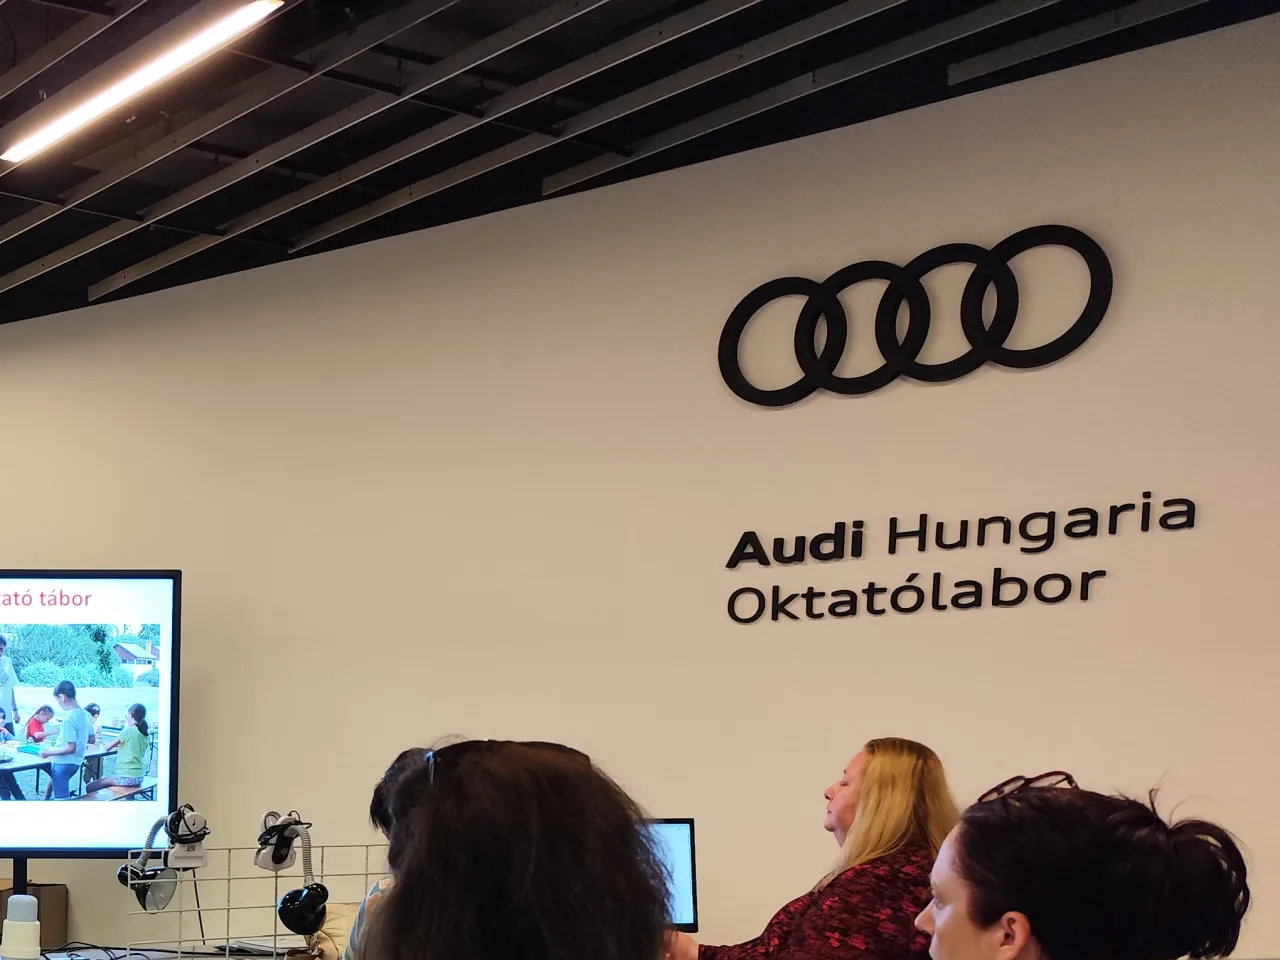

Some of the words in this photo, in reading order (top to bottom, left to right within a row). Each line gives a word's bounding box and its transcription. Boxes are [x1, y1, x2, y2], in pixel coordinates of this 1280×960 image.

[725, 520, 864, 568] Audi
[888, 491, 1197, 554] Hungaria
[39, 589, 92, 606] tábor
[727, 568, 1107, 624] Oktatólabor
